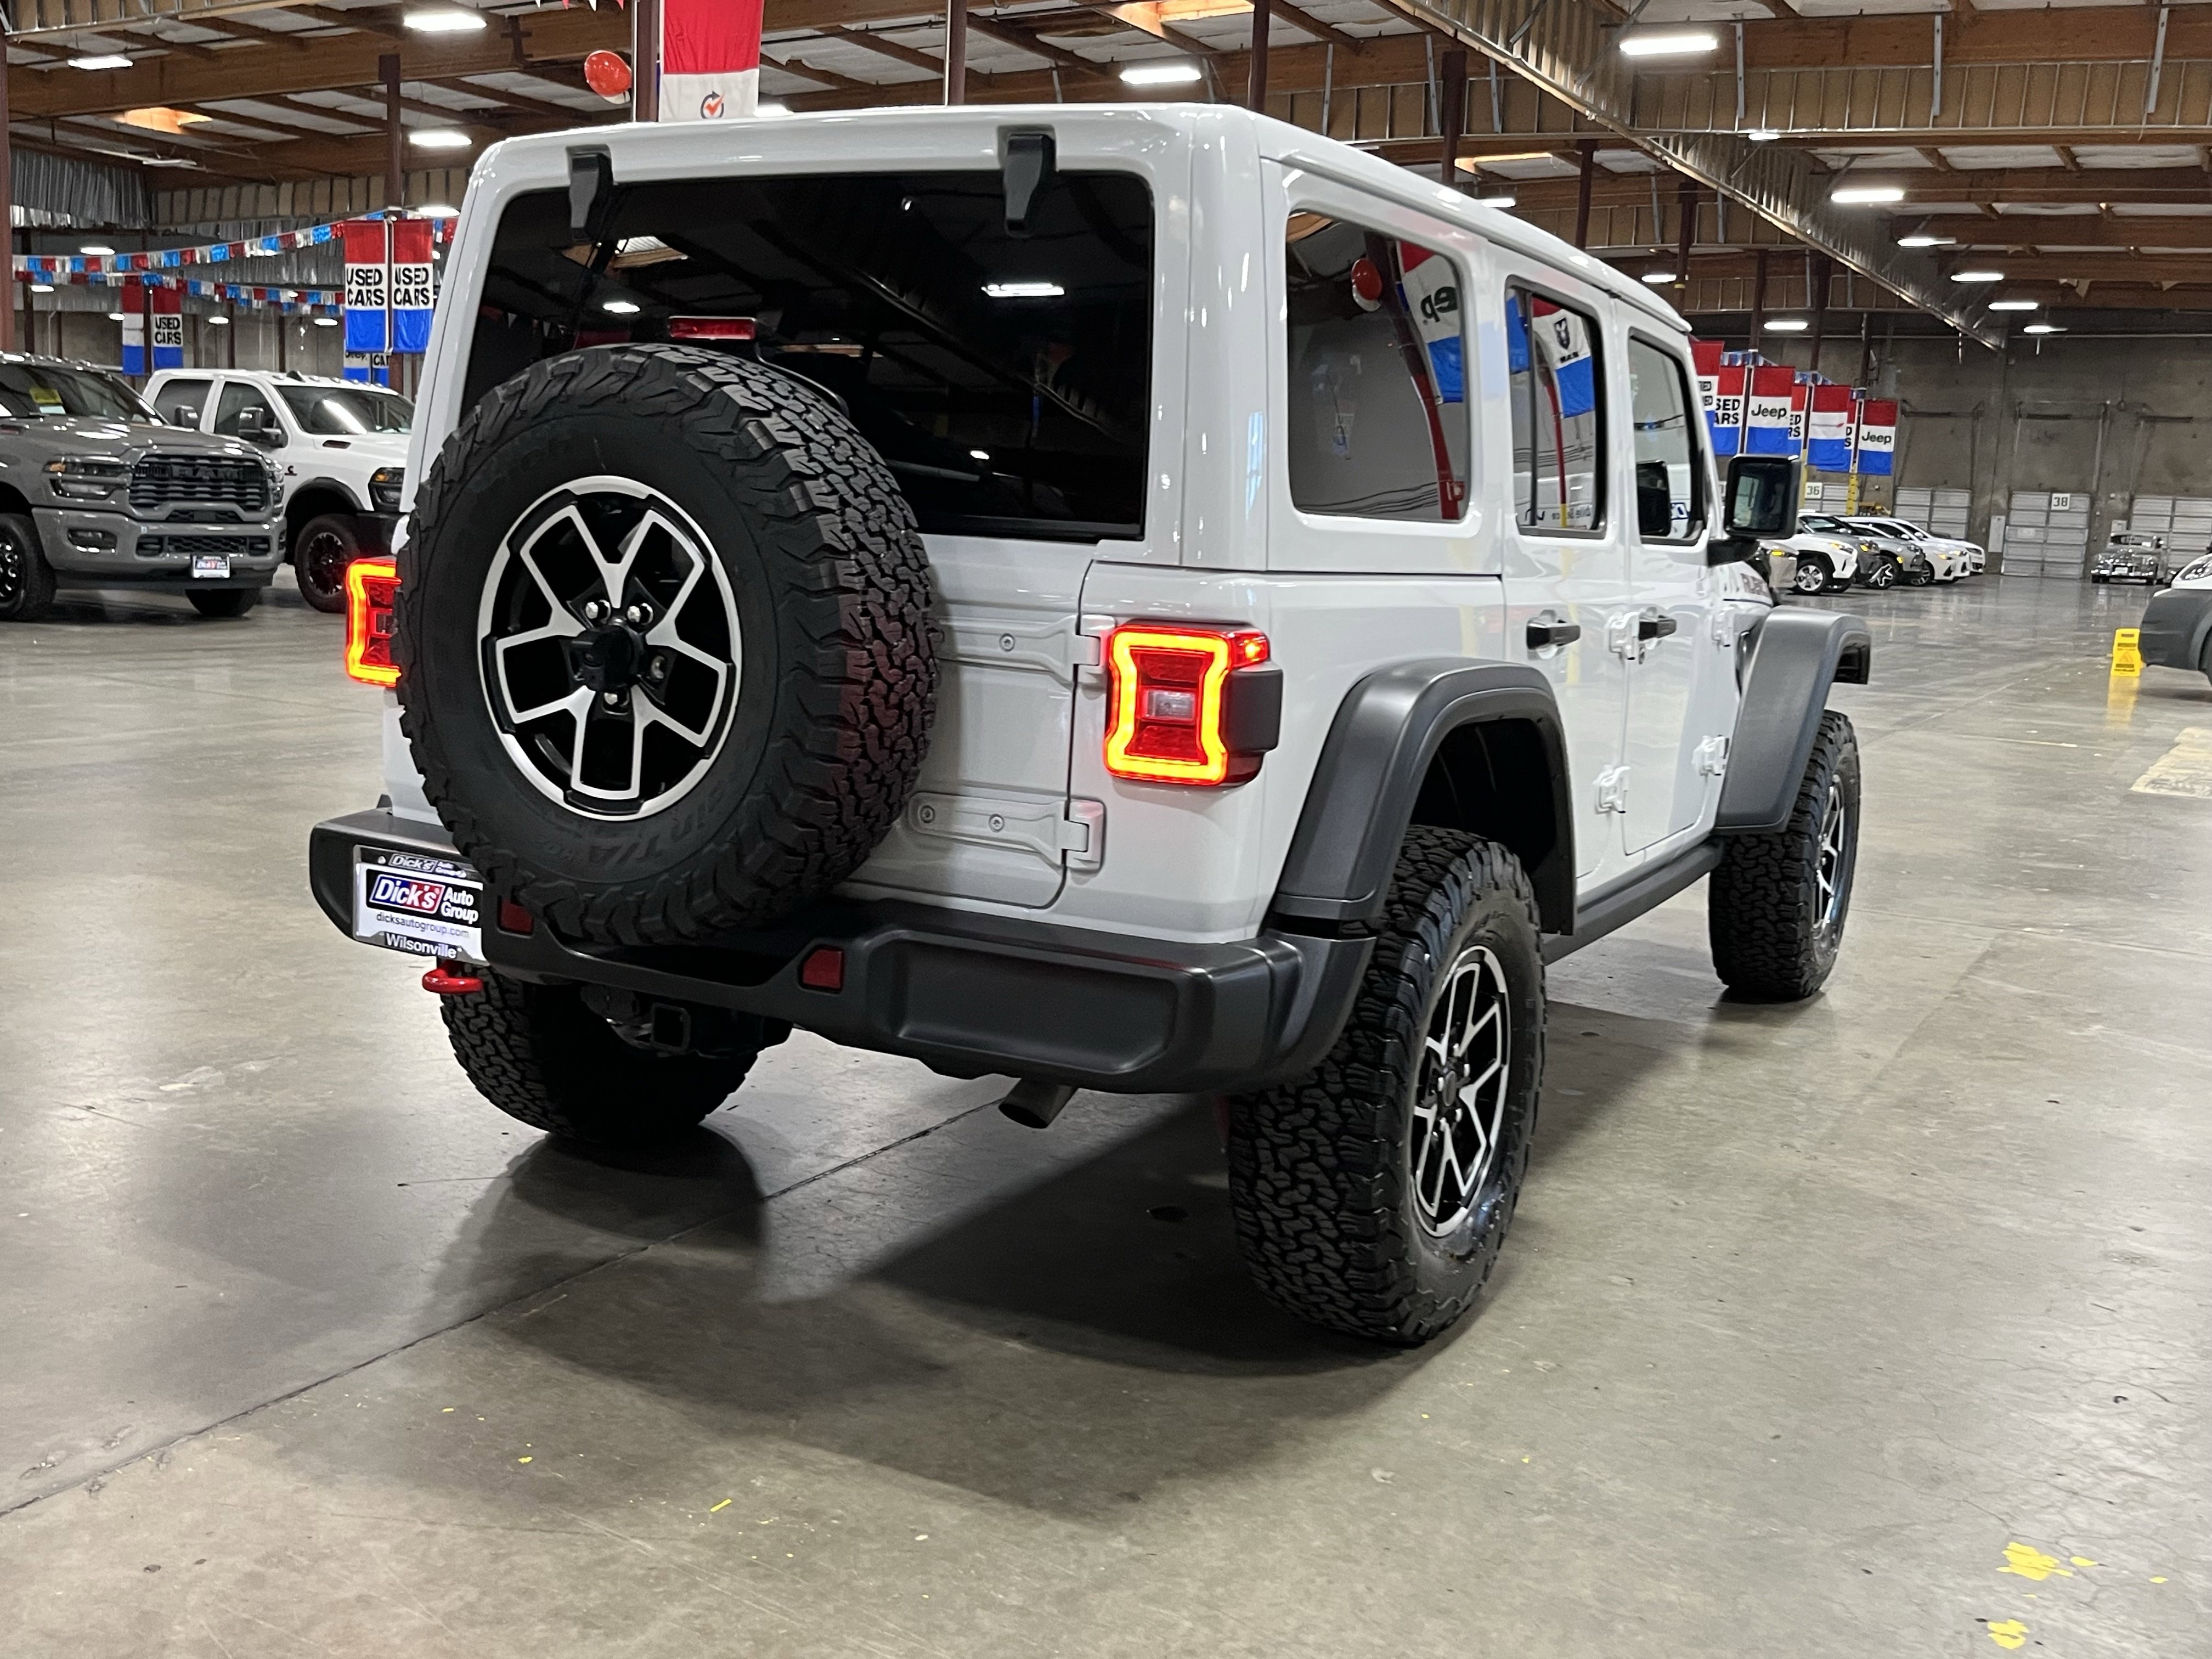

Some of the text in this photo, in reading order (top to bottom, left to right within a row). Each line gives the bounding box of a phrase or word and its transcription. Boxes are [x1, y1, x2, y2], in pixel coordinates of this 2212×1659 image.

[347, 268, 383, 286] USED
[395, 267, 429, 286] USED
[347, 288, 385, 306] CARS
[393, 287, 430, 306] CARS
[155, 317, 181, 330] USED
[1716, 398, 1740, 411] SED
[1751, 404, 1787, 420] Jeep
[1714, 413, 1739, 425] ARS
[1790, 414, 1802, 426] ED
[1861, 431, 1892, 445] Jeep
[1806, 486, 1820, 495] 36
[2053, 496, 2068, 507] 38
[392, 855, 434, 870] Dick's
[374, 878, 439, 909] Dick's
[443, 887, 474, 906] Auto
[441, 901, 479, 924] Group
[376, 912, 470, 938] dicksautogroup.com
[386, 933, 456, 959] Wilsonville
